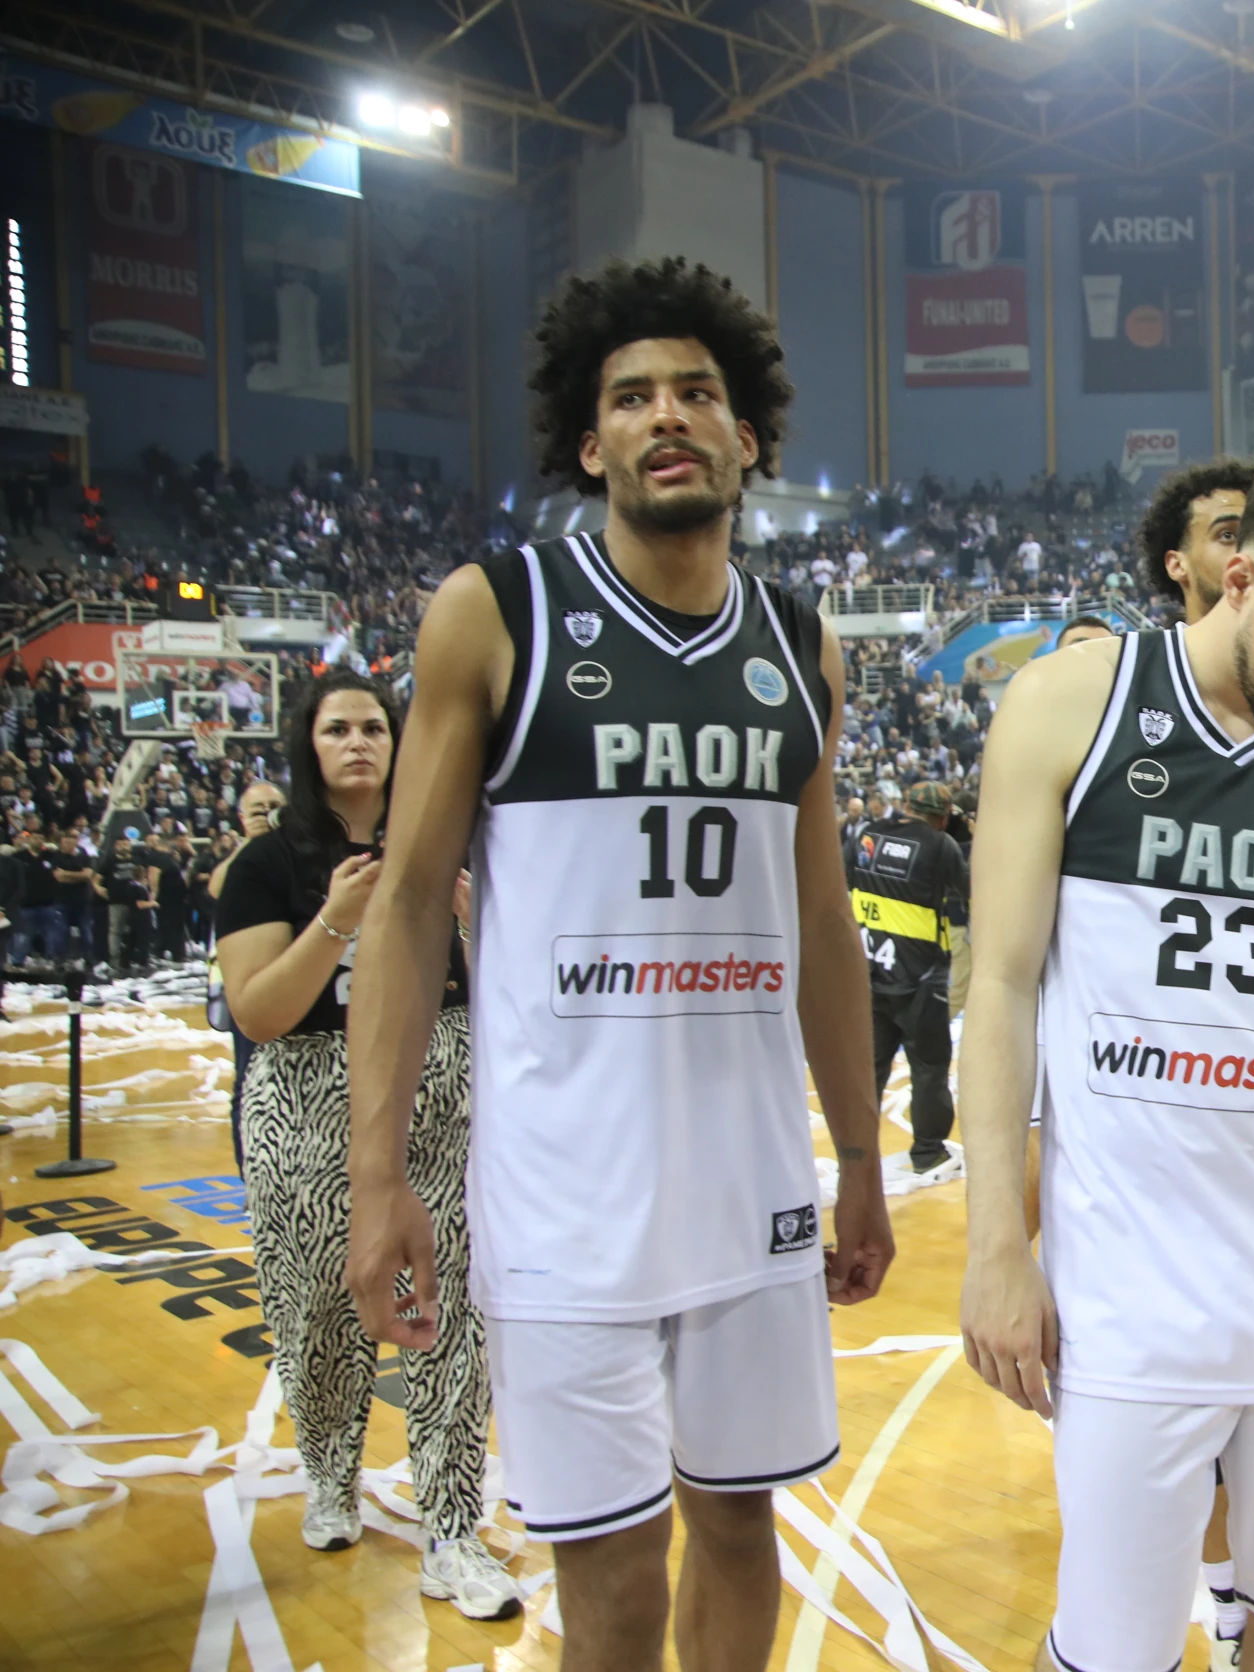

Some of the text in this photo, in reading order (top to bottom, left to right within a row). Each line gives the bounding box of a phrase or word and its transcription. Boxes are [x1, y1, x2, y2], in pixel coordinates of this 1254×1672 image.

[88, 252, 199, 298] MORRIS
[593, 722, 783, 793] PAOK
[640, 805, 738, 899] 10
[558, 952, 784, 995] winmasters
[139, 1175, 252, 1235] FIB
